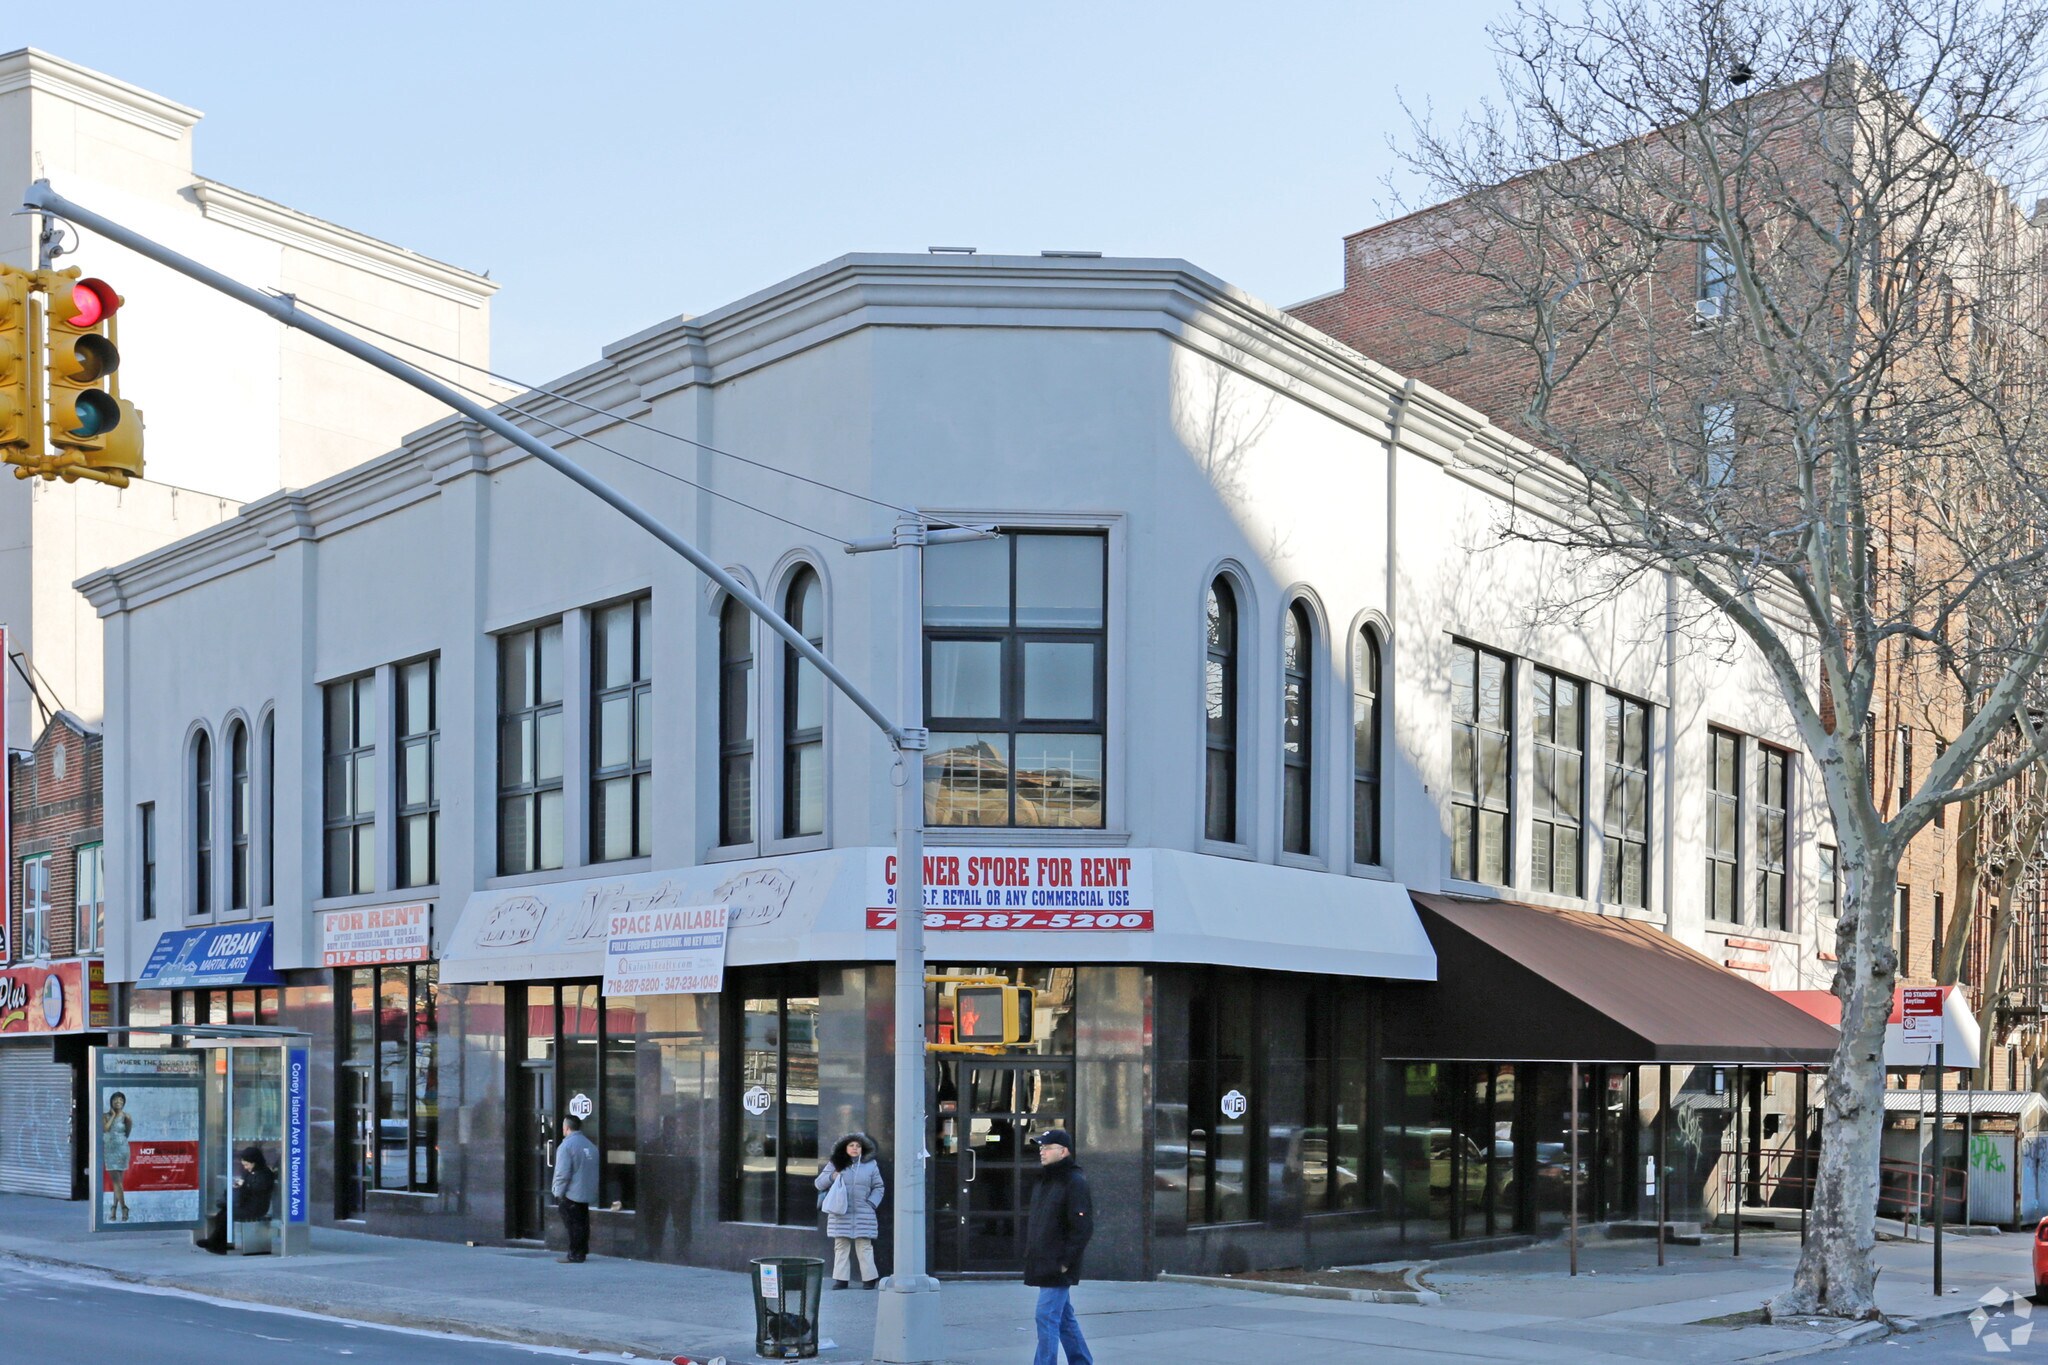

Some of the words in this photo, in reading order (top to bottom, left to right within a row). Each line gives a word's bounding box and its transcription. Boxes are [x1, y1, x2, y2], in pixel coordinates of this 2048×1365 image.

[885, 856, 960, 886] CNER
[968, 856, 1029, 887] STORE
[1037, 857, 1073, 887] FOR
[1080, 857, 1131, 887] RENT
[943, 889, 981, 906] RETAIL
[986, 889, 1001, 906] OR
[1005, 890, 1027, 906] ANY
[1032, 890, 1104, 907] COMMERCIAL
[1108, 890, 1130, 907] USE
[326, 912, 363, 932] FOR
[368, 906, 424, 929] RENT
[610, 914, 651, 936] SPACE
[653, 908, 726, 932] AVAILABLE
[876, 912, 1143, 929] 78-287-5200
[207, 931, 261, 958] URBAN
[199, 958, 229, 972] MARTIAL
[228, 957, 249, 970] ARTS
[326, 947, 422, 965] 917-680-6649
[607, 977, 660, 993] 718-287-5200
[664, 975, 719, 991] 347-234-1049
[290, 1062, 301, 1094] Coney
[291, 1096, 301, 1125] Island
[291, 1127, 301, 1146] Ave
[291, 1147, 301, 1155] &
[291, 1156, 301, 1196] Newkirk
[291, 1197, 301, 1216] Ave
